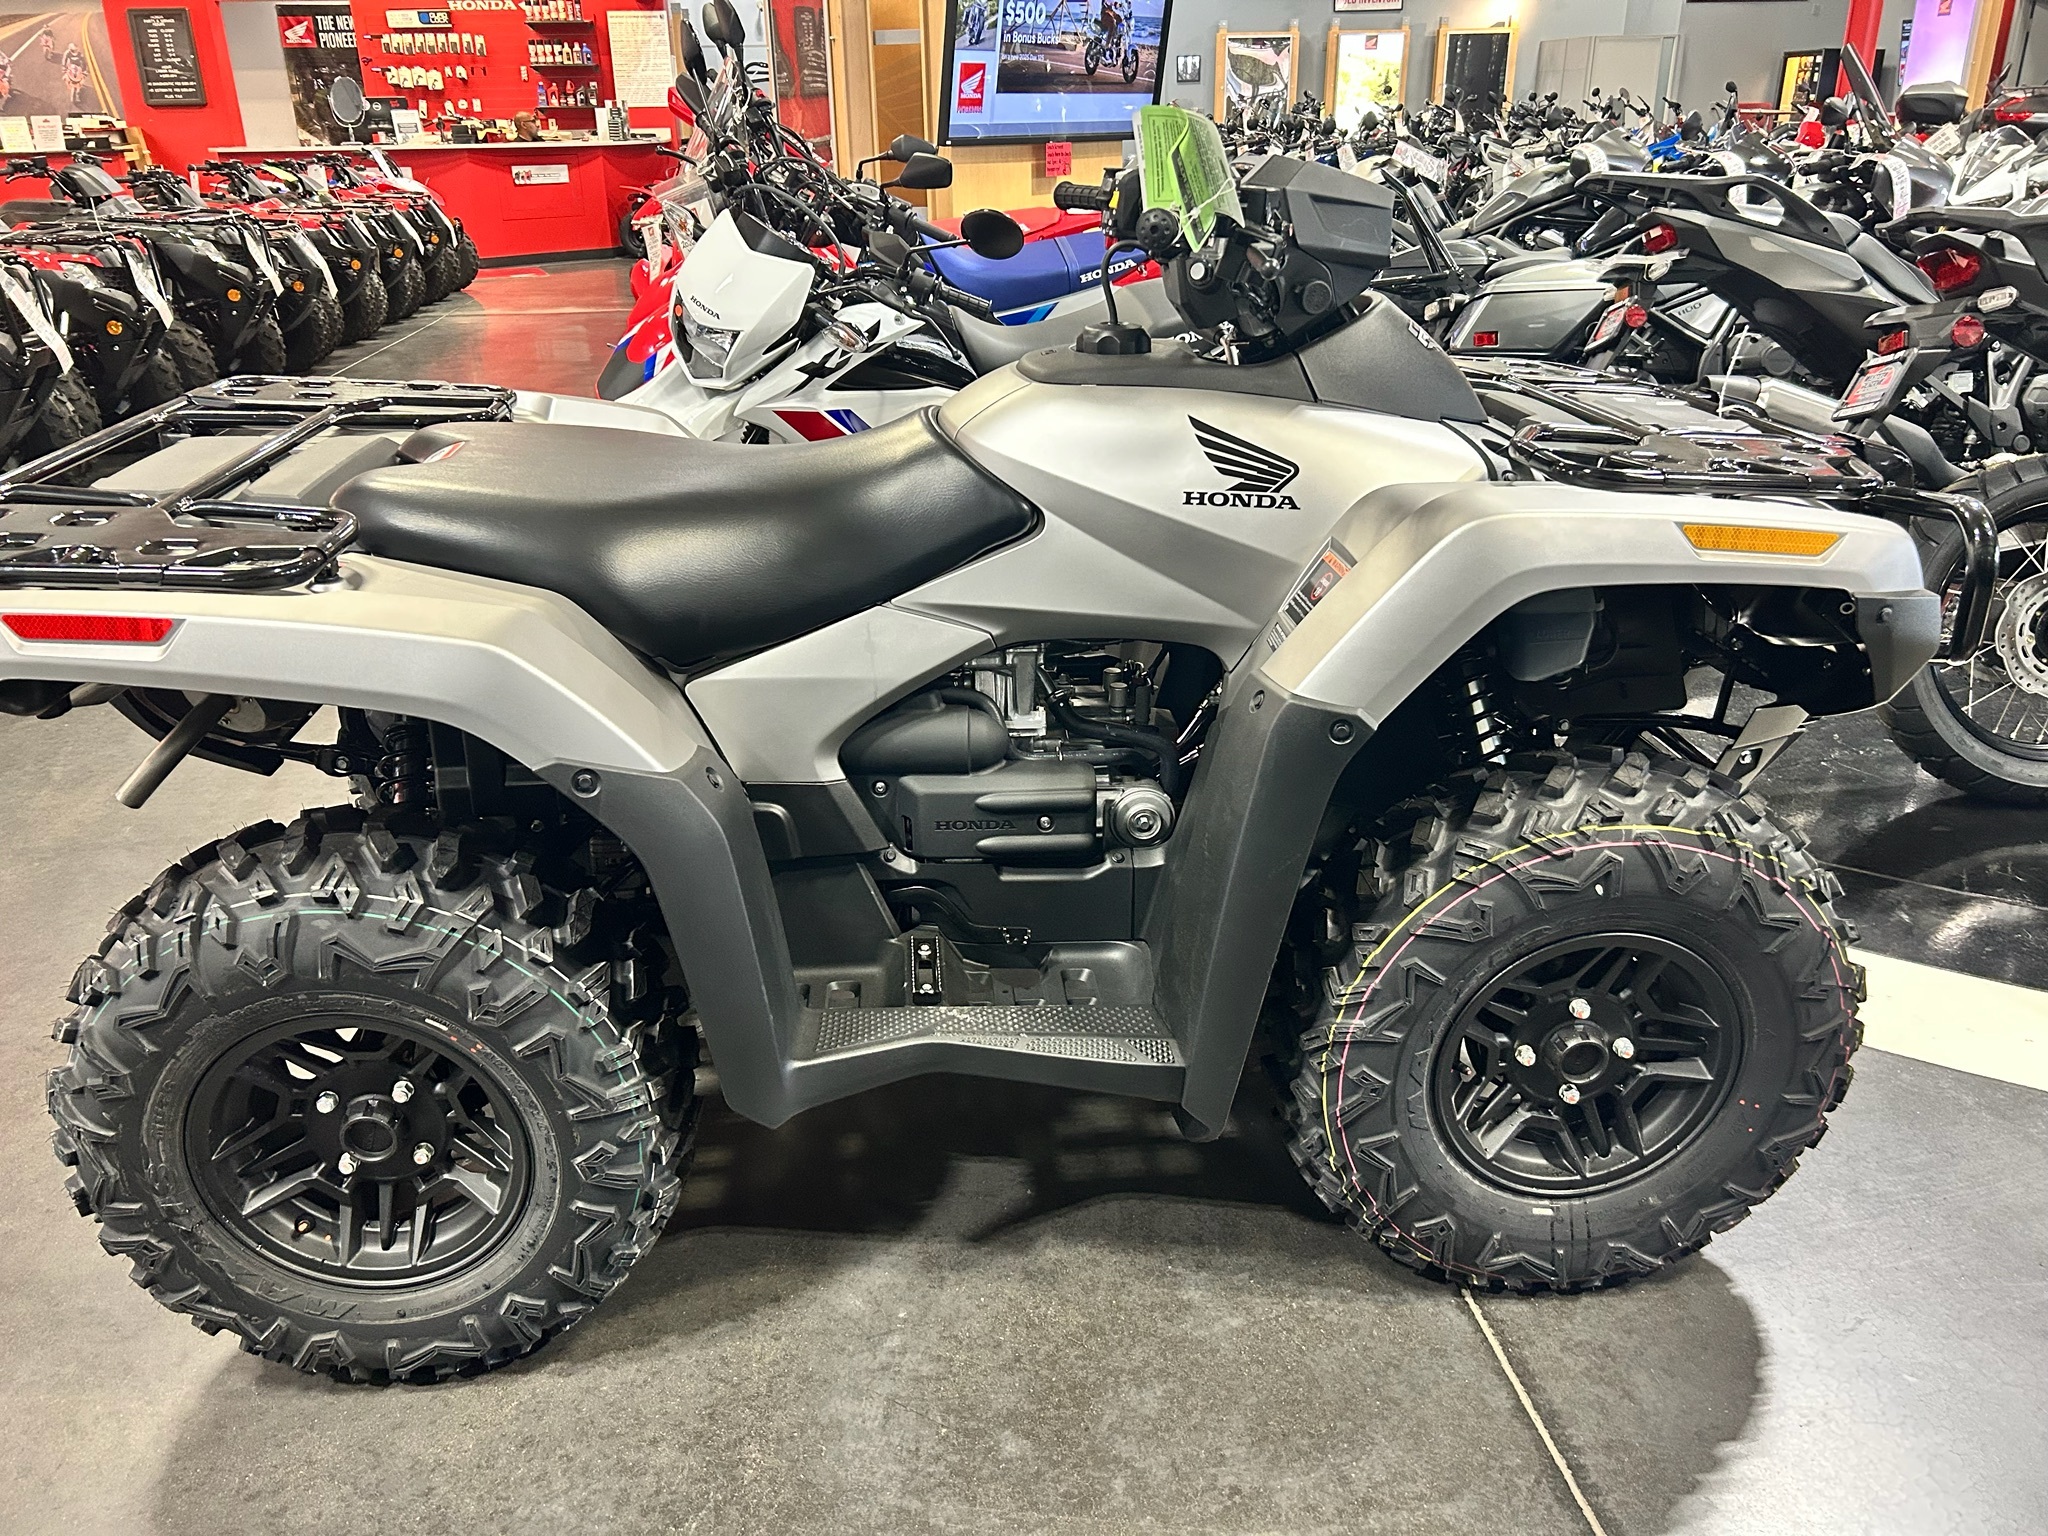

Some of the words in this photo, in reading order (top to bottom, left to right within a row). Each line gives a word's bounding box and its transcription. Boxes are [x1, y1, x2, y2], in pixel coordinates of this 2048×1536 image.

[447, 0, 517, 10] HONDA
[1006, 0, 1046, 25] $500
[315, 15, 335, 31] THE
[319, 32, 357, 49] PIONEE
[1003, 31, 1011, 43] in
[1012, 31, 1036, 44] Bonus
[1037, 32, 1059, 45] Bucks
[1079, 258, 1138, 285] HONDA
[690, 294, 721, 320] HONDA
[1183, 491, 1301, 511] HONDA
[934, 820, 1017, 831] HONDA
